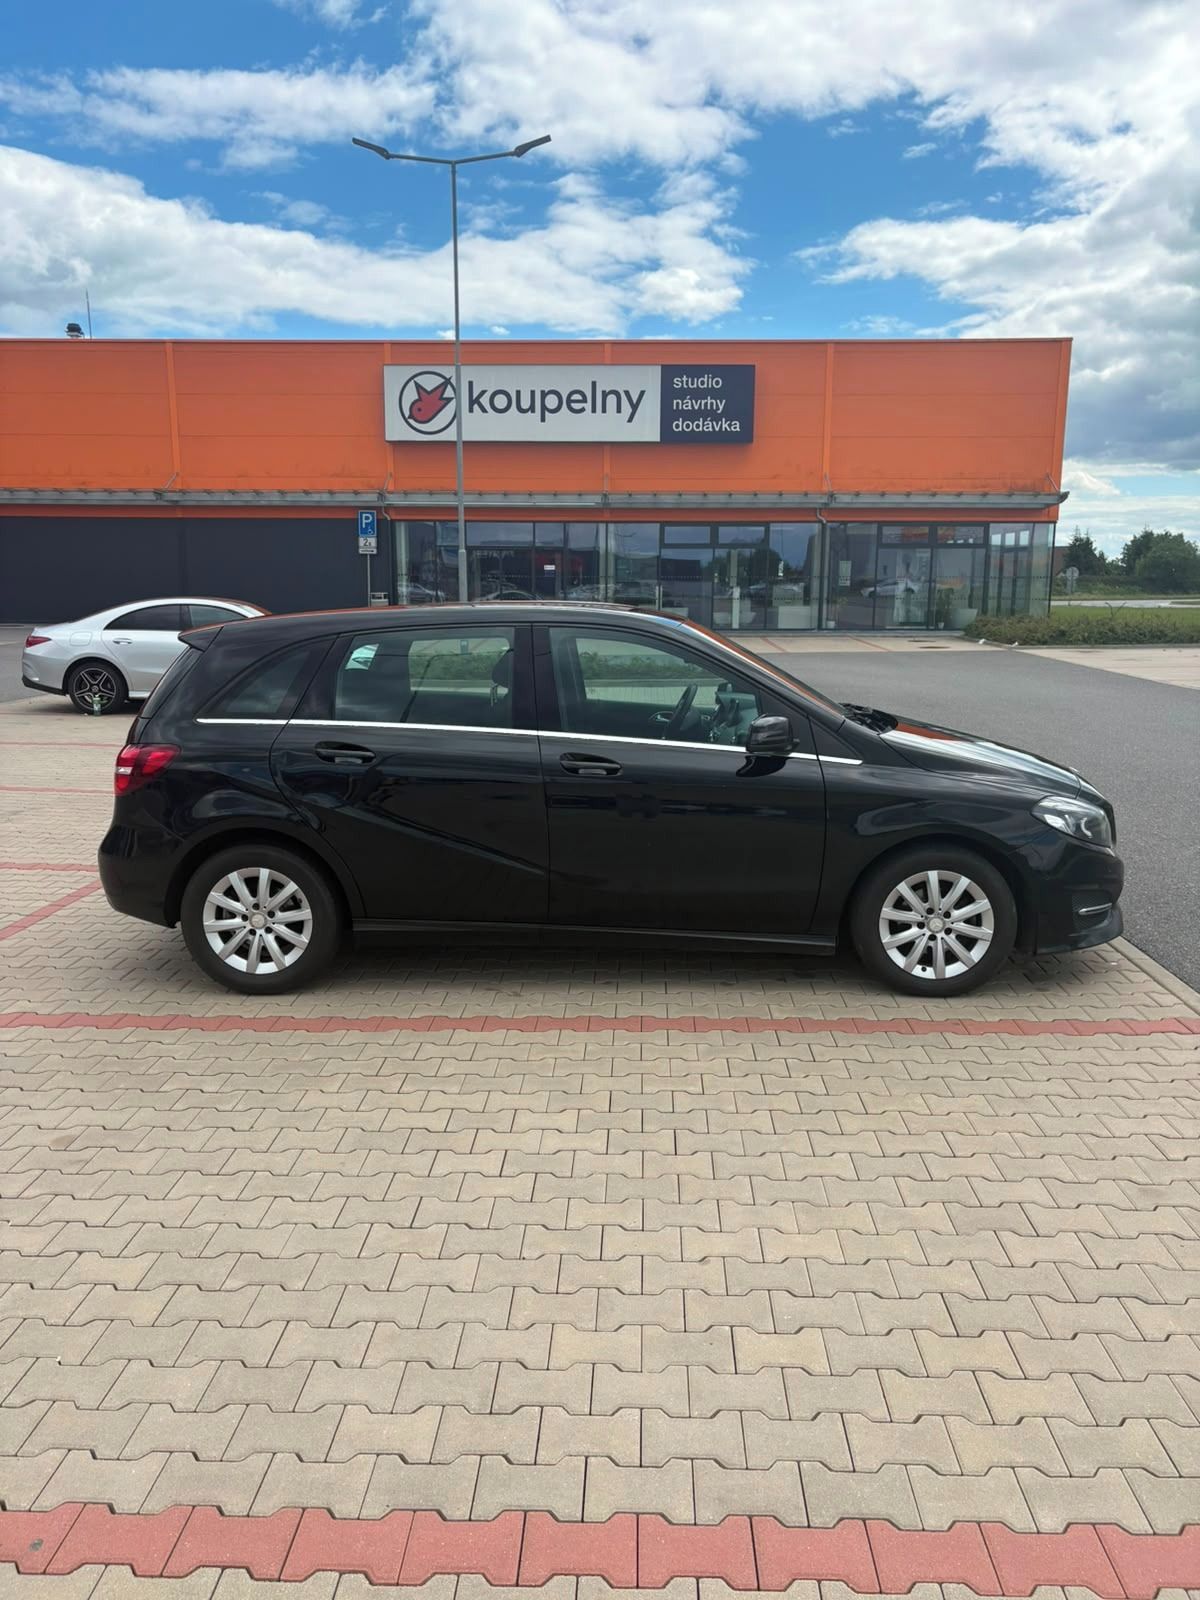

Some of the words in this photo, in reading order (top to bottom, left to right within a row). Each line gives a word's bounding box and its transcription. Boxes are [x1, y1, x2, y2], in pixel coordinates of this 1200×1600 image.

[673, 374, 722, 388] studio
[468, 380, 646, 423] koupelny
[673, 396, 726, 413] návrhy
[672, 417, 741, 432] dodávka
[362, 513, 373, 528] P
